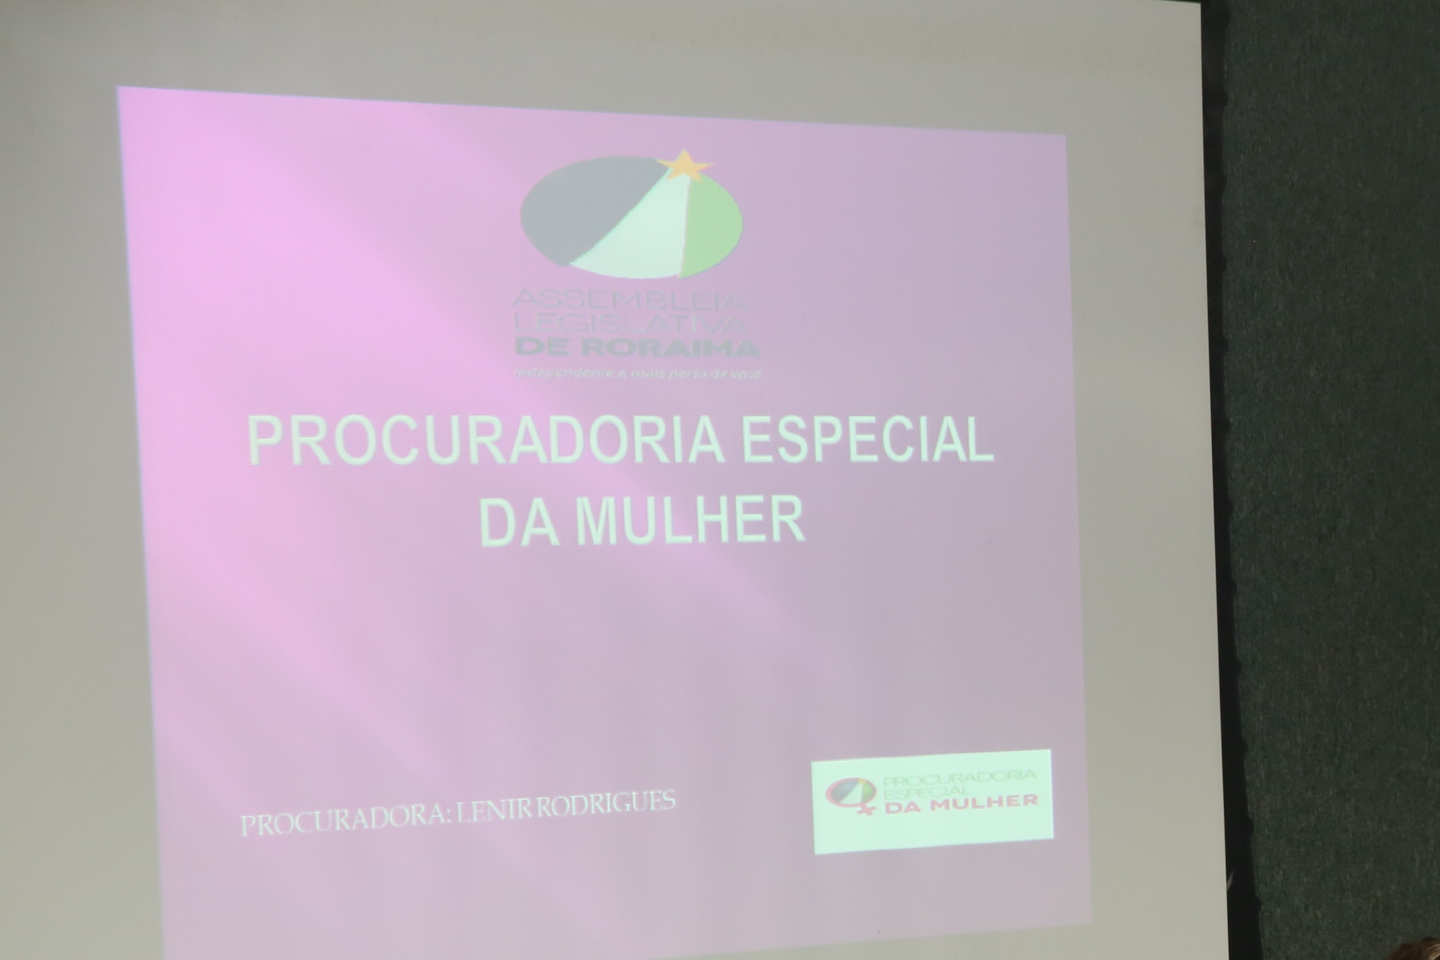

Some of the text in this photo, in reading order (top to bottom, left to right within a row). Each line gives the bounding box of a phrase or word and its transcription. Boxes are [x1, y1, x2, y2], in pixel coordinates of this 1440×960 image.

[515, 336, 762, 360] DE RORAIMA
[248, 413, 995, 466] PROCURADORIA ESPECIAL
[479, 494, 806, 547] DA MULHER
[883, 769, 1037, 787] PROCURADORIA
[883, 786, 972, 800] ESPECIAL
[885, 794, 1039, 815] DA MULHER
[240, 788, 677, 837] PROCURADORA: LENIR RODRIGUES
